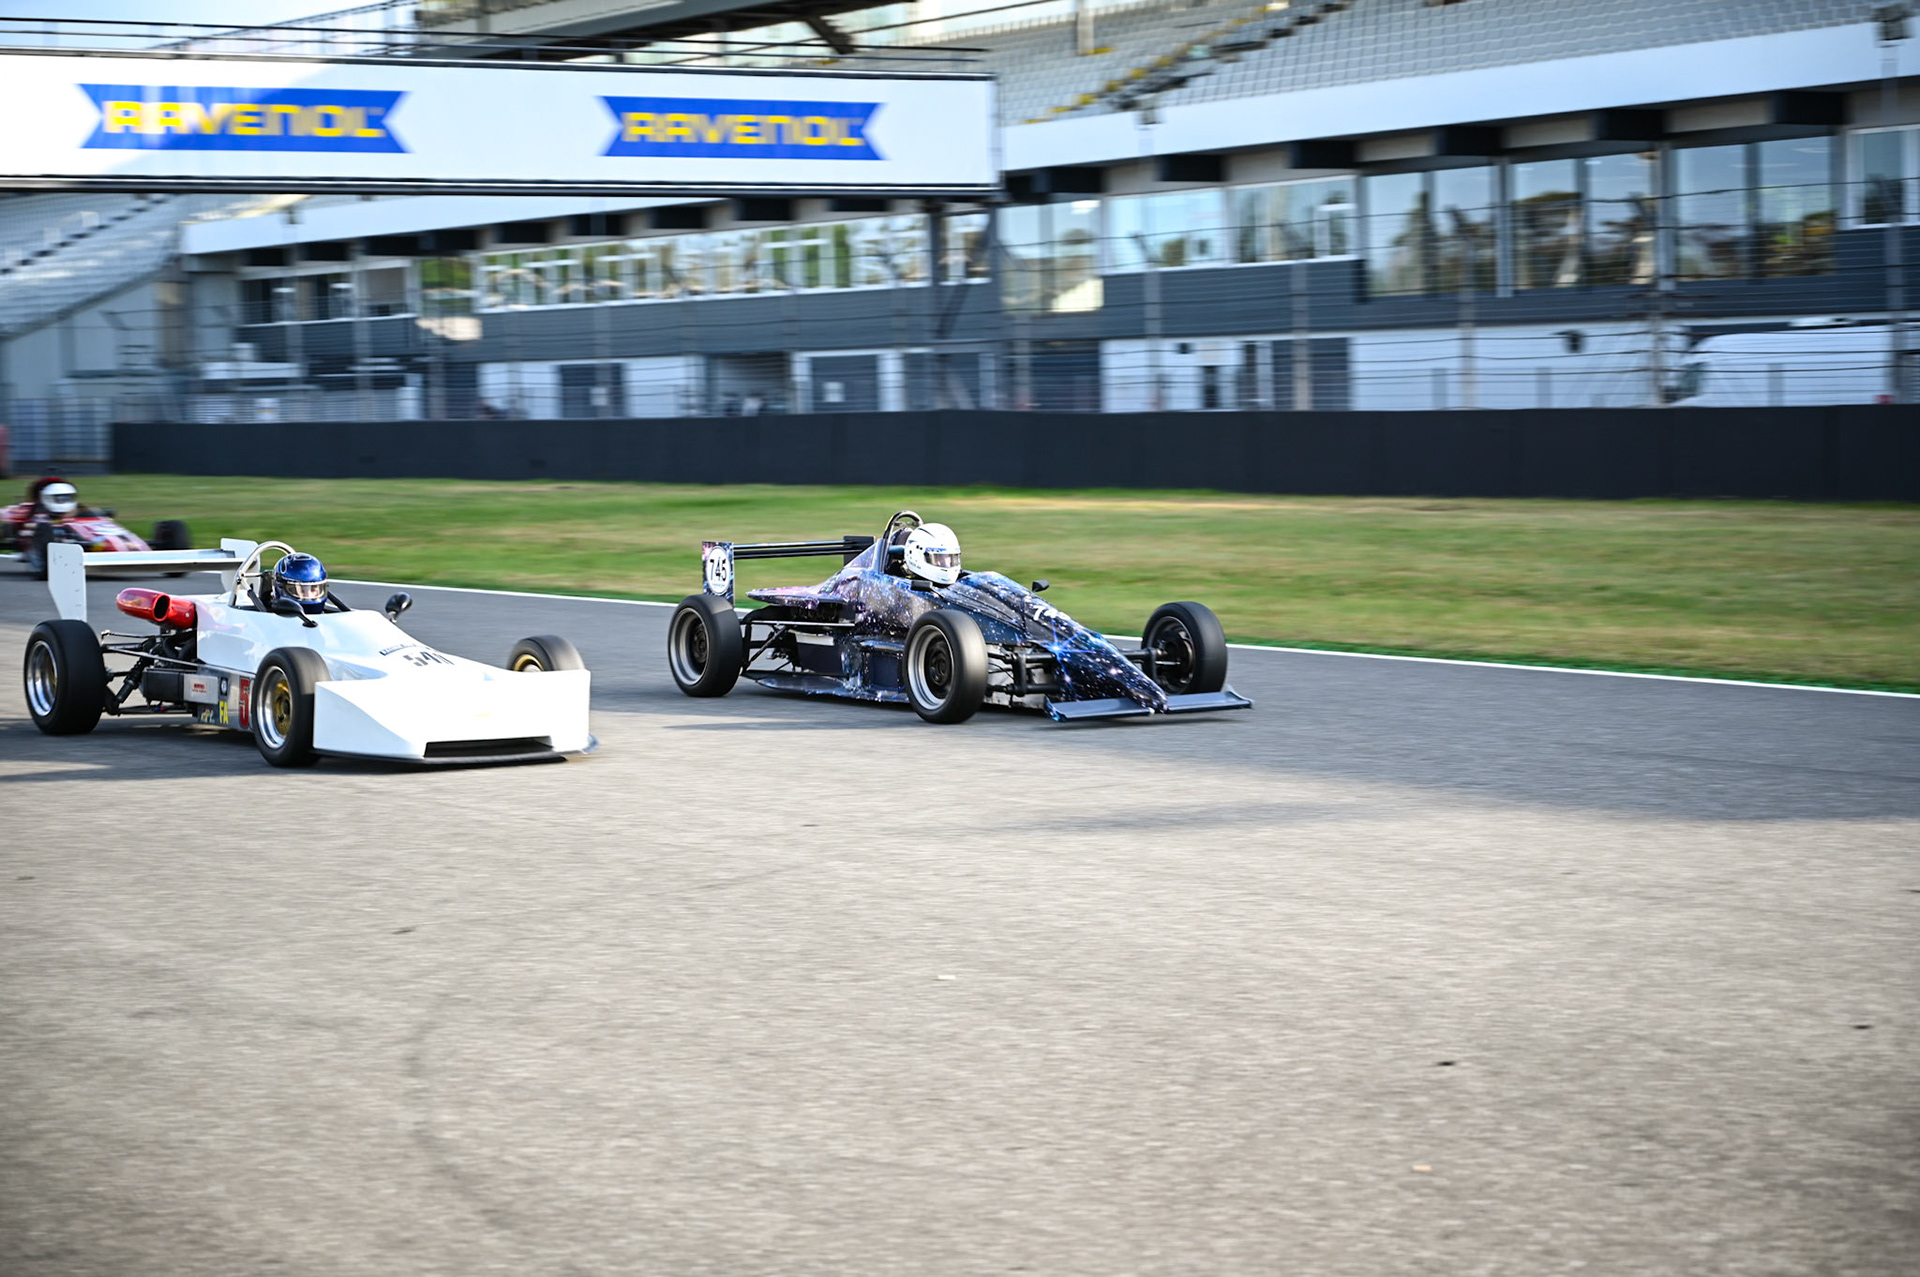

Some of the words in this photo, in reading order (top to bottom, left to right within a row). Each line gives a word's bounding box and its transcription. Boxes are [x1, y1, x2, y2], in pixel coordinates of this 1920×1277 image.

[103, 101, 387, 138] RAVENOL
[621, 111, 865, 146] RAVENOL
[709, 556, 727, 582] 745
[219, 700, 229, 725] FA
